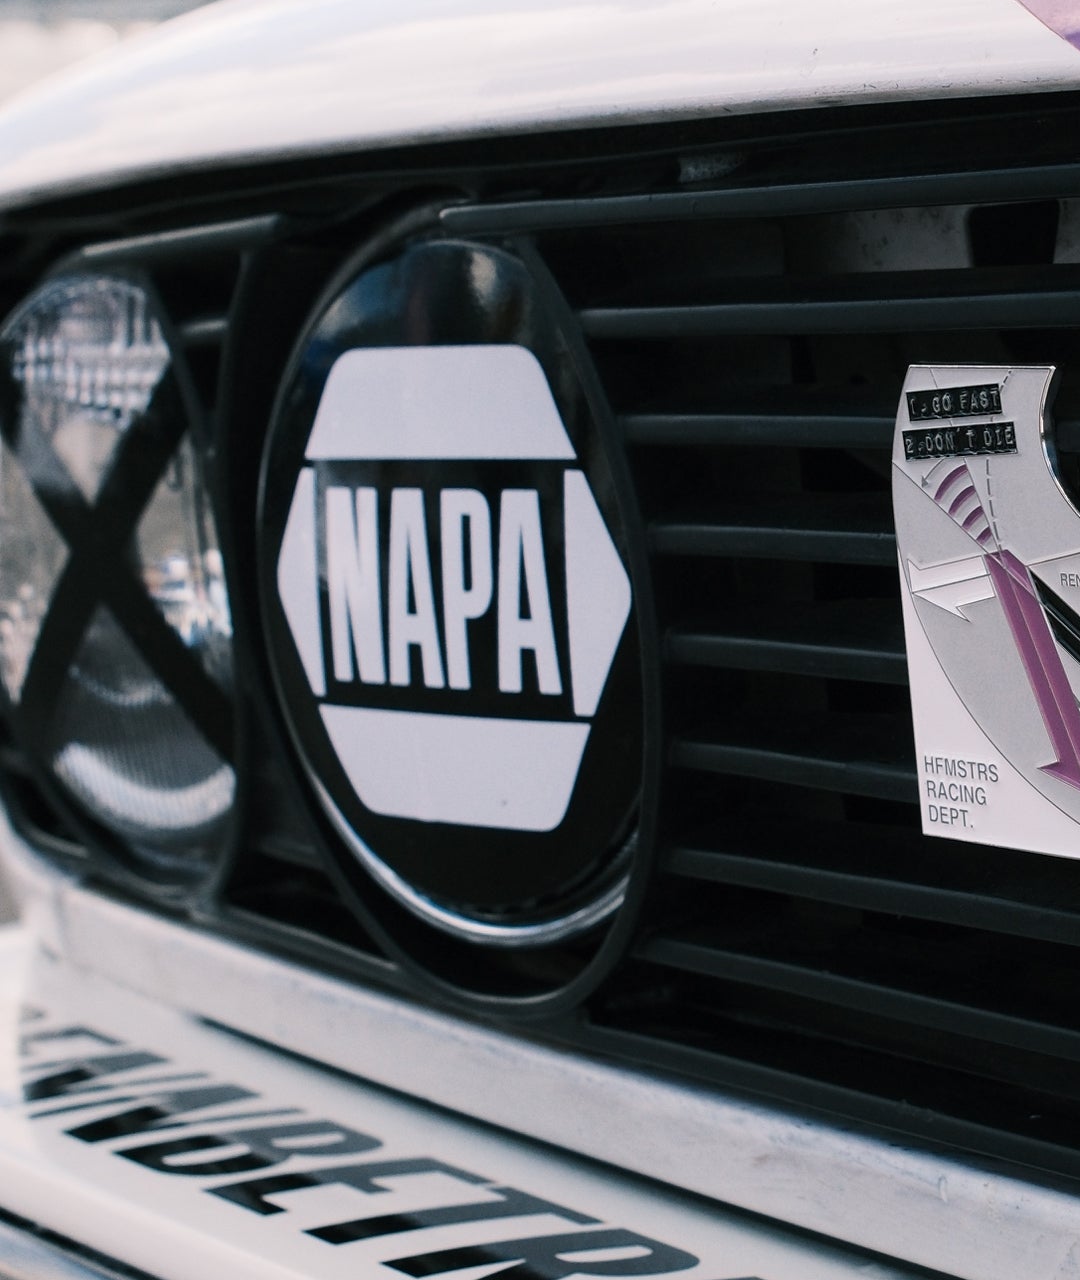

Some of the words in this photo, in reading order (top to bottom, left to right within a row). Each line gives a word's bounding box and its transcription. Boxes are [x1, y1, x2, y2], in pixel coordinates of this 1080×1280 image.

[959, 386, 999, 410] FAST
[983, 425, 1014, 447] DIE
[325, 486, 562, 695] NAPA
[924, 755, 999, 783] HFMSTRS
[926, 780, 987, 806] RACING
[928, 804, 974, 829] DEPT.
